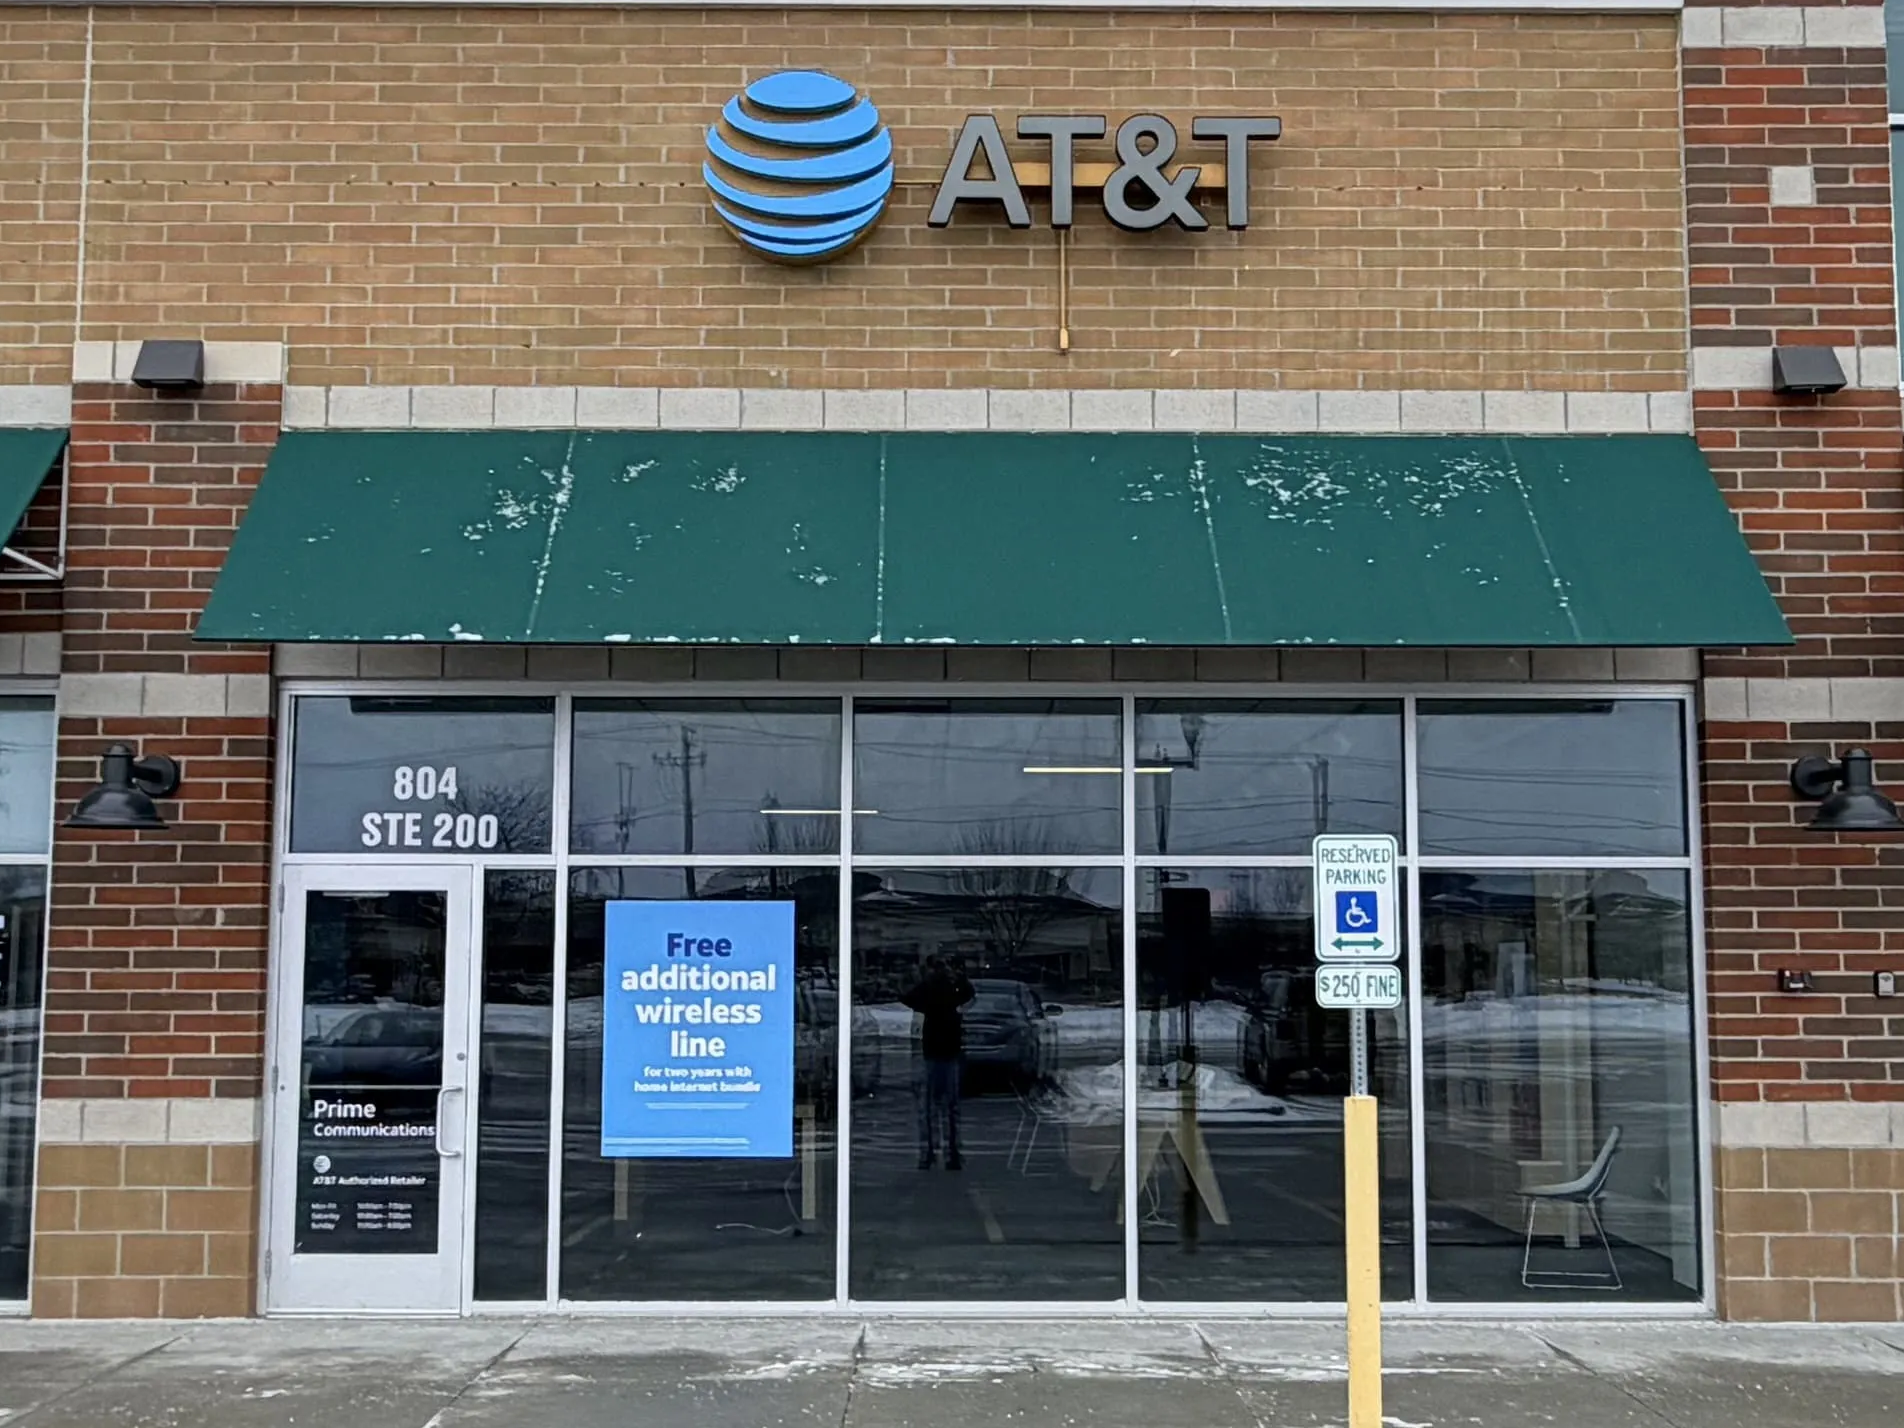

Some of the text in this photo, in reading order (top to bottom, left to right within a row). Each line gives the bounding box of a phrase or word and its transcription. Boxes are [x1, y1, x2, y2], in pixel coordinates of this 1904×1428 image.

[927, 114, 1282, 231] AT&T
[393, 766, 458, 800] 804
[361, 812, 498, 848] STE 200
[1321, 848, 1391, 863] RESERVED
[1326, 869, 1387, 884] PARKING
[667, 933, 732, 957] Free
[621, 963, 776, 991] additional
[1366, 974, 1396, 997] FINE
[635, 997, 762, 1024] wireless
[670, 1030, 726, 1058] line
[644, 1066, 752, 1080] for two years with
[634, 1081, 761, 1092] home internet bundle
[314, 1099, 376, 1118] Prime
[314, 1122, 435, 1137] Communications
[313, 1176, 427, 1185] AT&T Authorized Retailer
